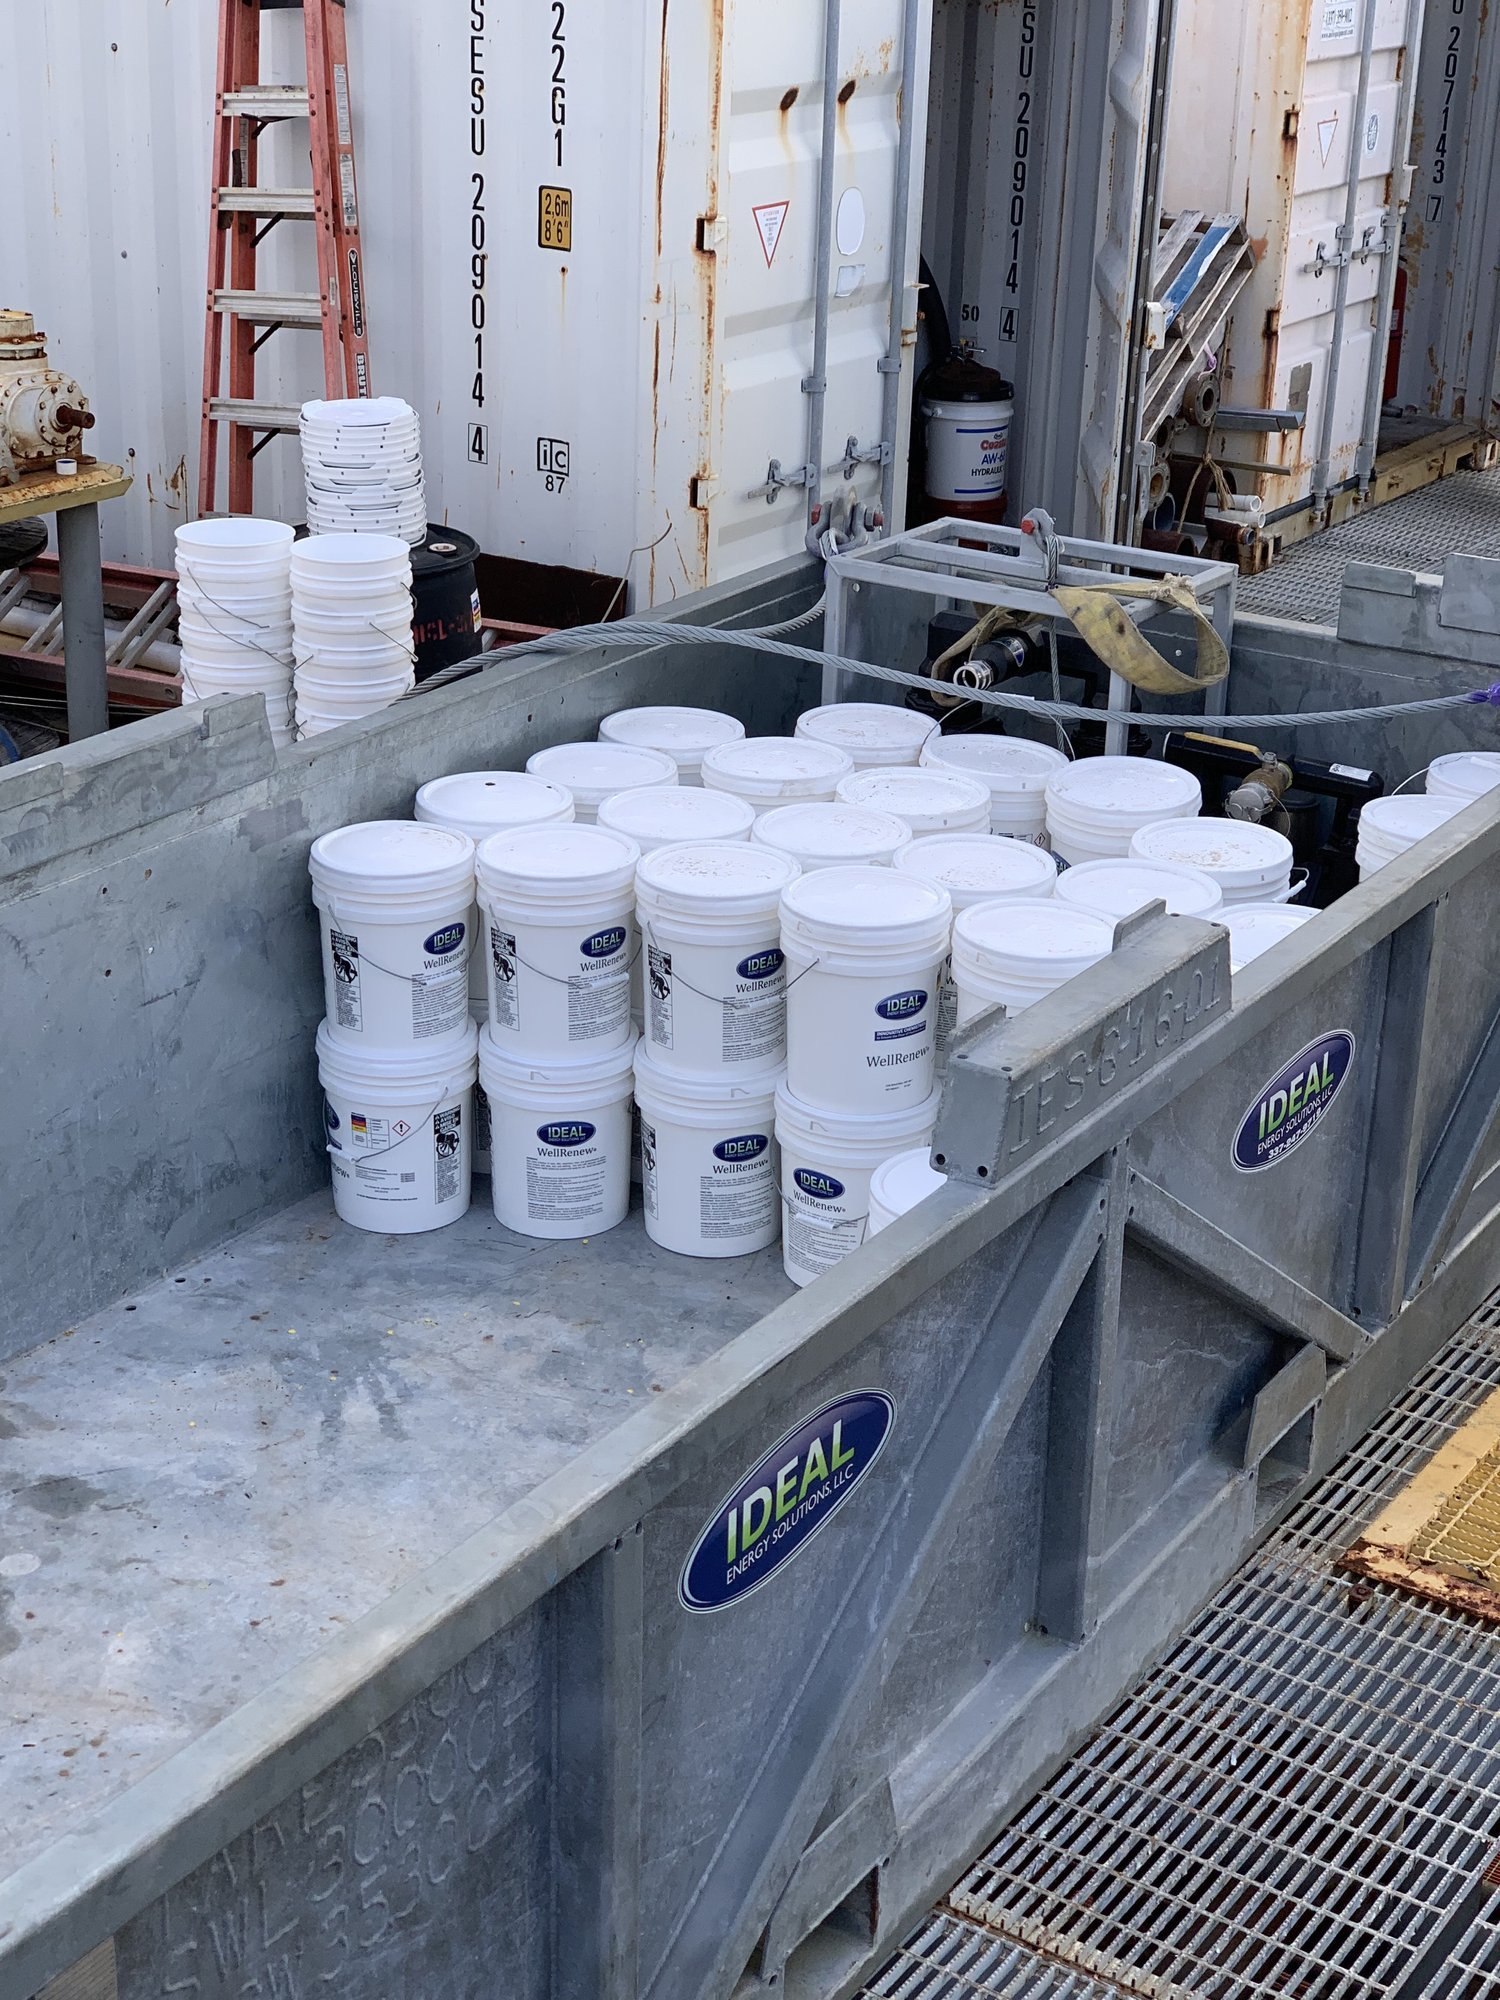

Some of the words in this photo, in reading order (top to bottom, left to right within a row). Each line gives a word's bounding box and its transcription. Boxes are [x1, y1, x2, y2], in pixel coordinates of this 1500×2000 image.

[1019, 0, 1036, 78] SU
[470, 0, 485, 156] SESU
[551, 2, 566, 166] 22G1
[1432, 26, 1460, 184] 207143
[1005, 92, 1031, 294] 209014
[1430, 196, 1442, 221] 7
[351, 264, 363, 335] LOUISVILLE
[471, 173, 485, 408] 209014
[961, 304, 980, 322] 50
[1003, 309, 1015, 340] 4
[471, 426, 485, 461] 4
[545, 474, 566, 494] 87
[433, 927, 461, 948] IDEAL
[591, 931, 621, 950] IDEAL
[747, 953, 778, 972] IDEAL
[887, 994, 921, 1012] IDEAL
[1258, 1051, 1334, 1140] IDEAL
[547, 1126, 586, 1138] IDEAL
[1257, 1126, 1286, 1155] ENERGY
[1321, 1083, 1334, 1103] LLC
[724, 1139, 760, 1154] IDEAL
[800, 1171, 834, 1192] IDEAL
[727, 1418, 855, 1565] IDEAL
[726, 1534, 771, 1585] ENERGY
[771, 1481, 833, 1545] SOLUTIONS,
[833, 1463, 855, 1490] LLC
